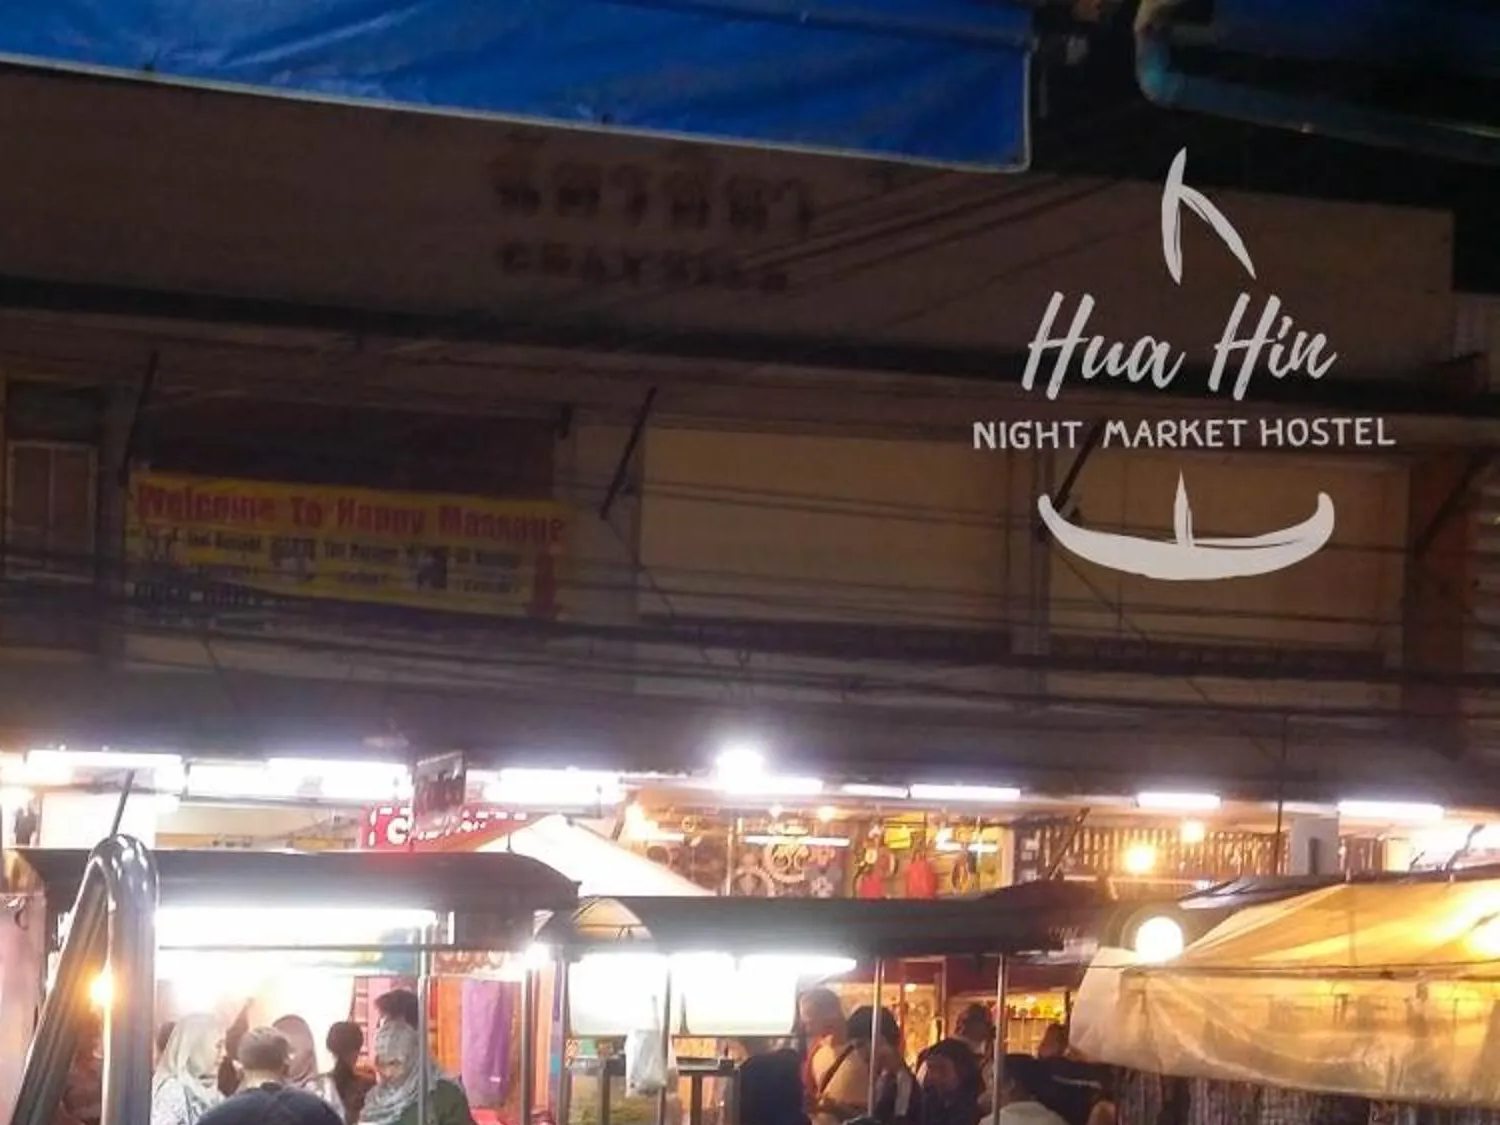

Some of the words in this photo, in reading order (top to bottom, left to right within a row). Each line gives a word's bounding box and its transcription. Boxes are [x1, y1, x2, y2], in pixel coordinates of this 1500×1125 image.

[137, 482, 276, 524] Welcome
[291, 496, 323, 529] To
[338, 497, 425, 536] Happy
